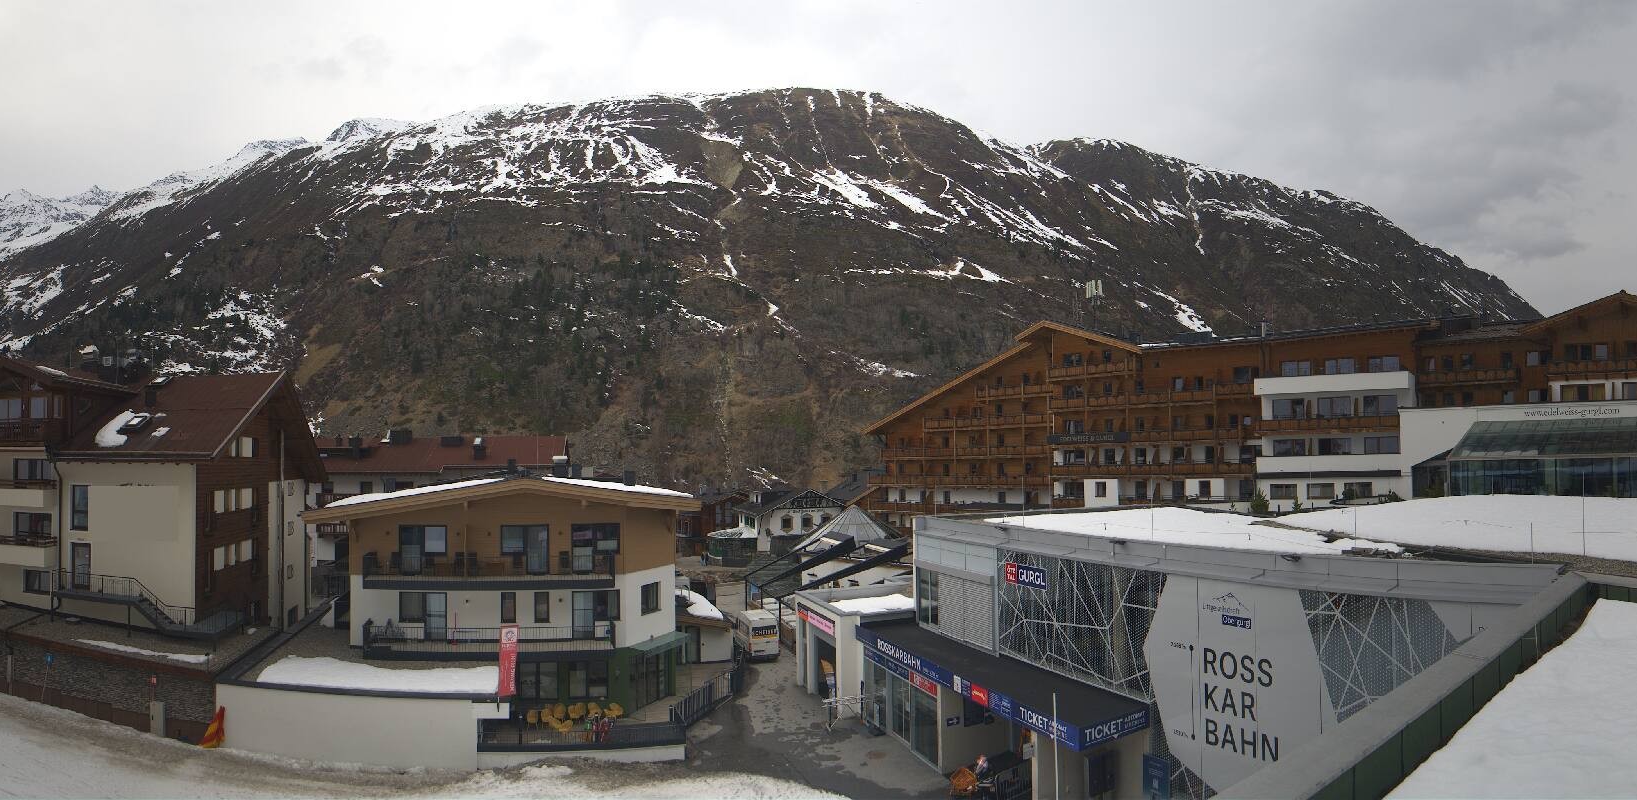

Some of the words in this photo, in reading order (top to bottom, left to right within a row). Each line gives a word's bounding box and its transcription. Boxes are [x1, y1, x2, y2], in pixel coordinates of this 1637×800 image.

[1019, 569, 1045, 585] GURGL
[877, 639, 921, 670] ROSSKARBAHN
[1204, 647, 1273, 688] ROSS
[1204, 683, 1257, 721] KAR
[1019, 706, 1049, 730] TICKET
[1084, 719, 1123, 742] TICKET
[1205, 718, 1279, 761] BAHN
